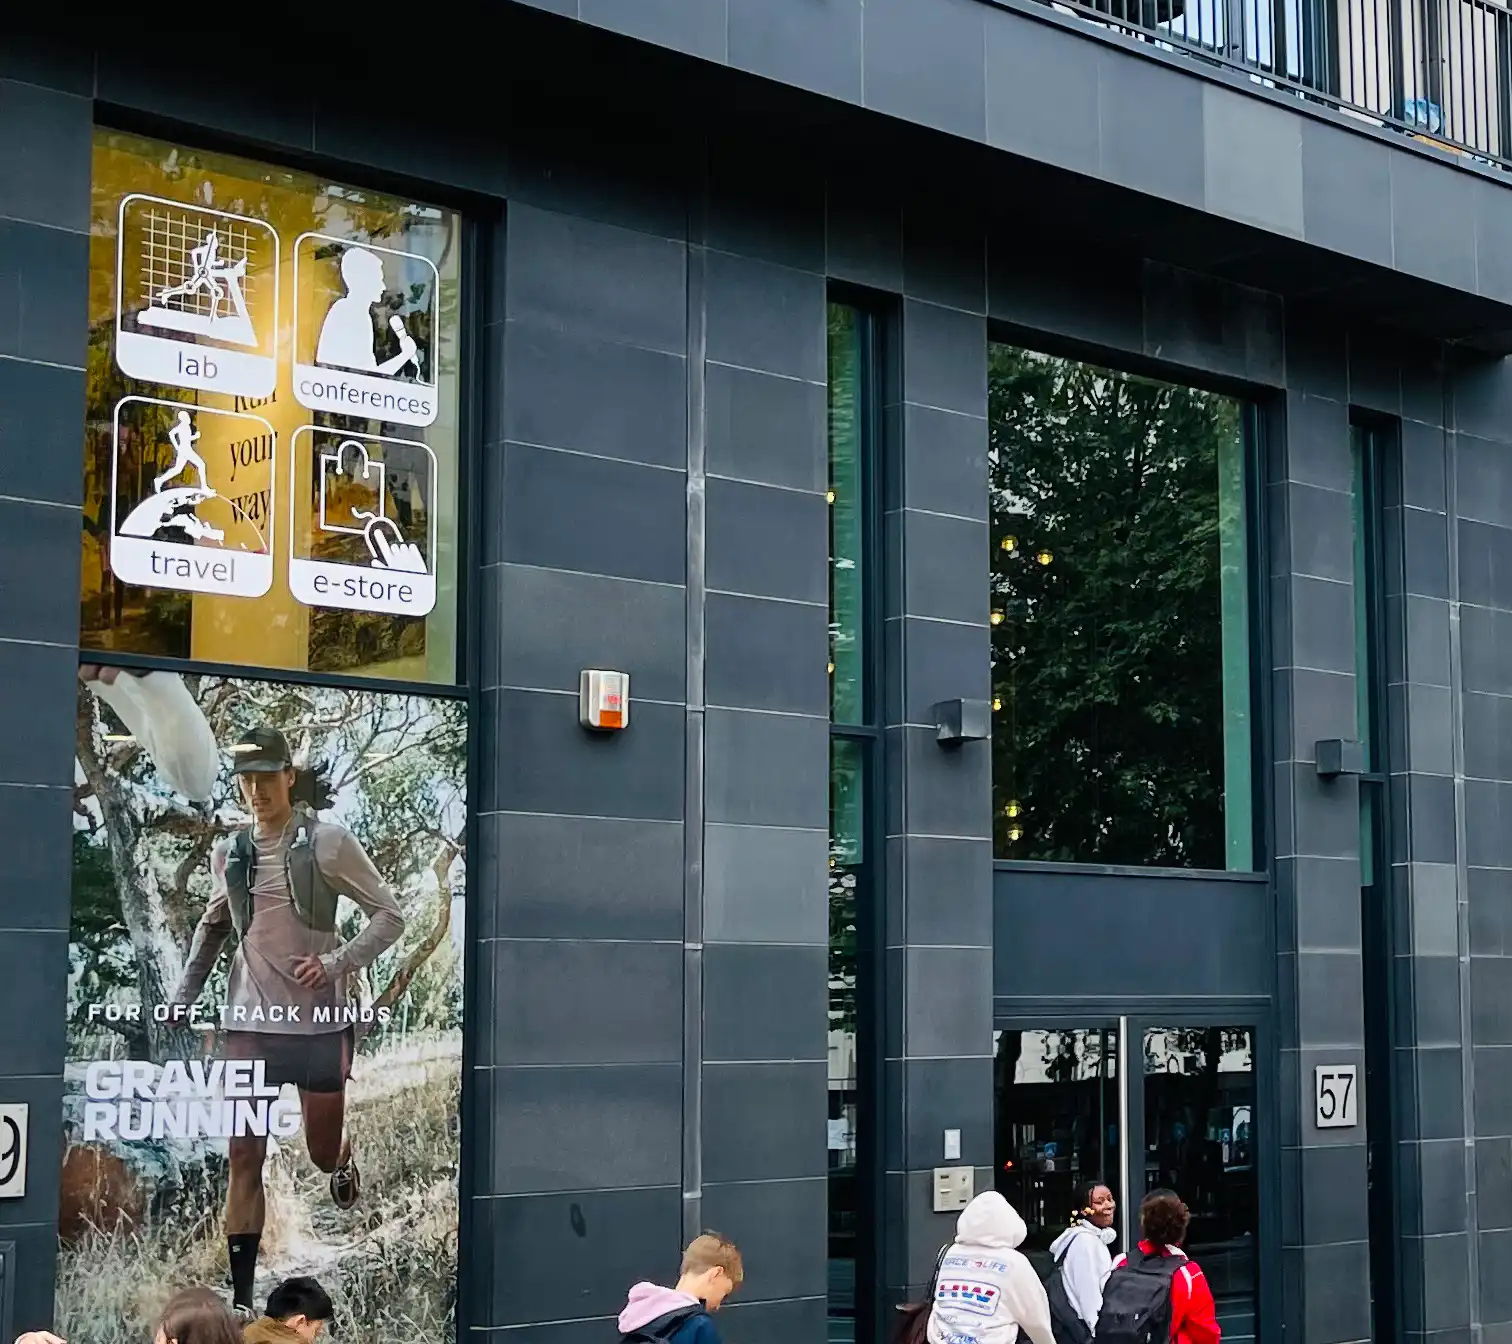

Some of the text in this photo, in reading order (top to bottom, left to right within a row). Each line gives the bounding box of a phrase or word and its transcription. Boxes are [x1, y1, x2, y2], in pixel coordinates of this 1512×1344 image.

[177, 351, 218, 379] lab
[300, 379, 431, 416] conferences
[151, 550, 235, 583] travel
[313, 573, 413, 603] e-store
[88, 1003, 392, 1024] FOR OFF TRACK MINDS
[84, 1059, 280, 1100] GRAVEL
[1320, 1073, 1354, 1120] 57
[83, 1099, 301, 1142] RUNNING
